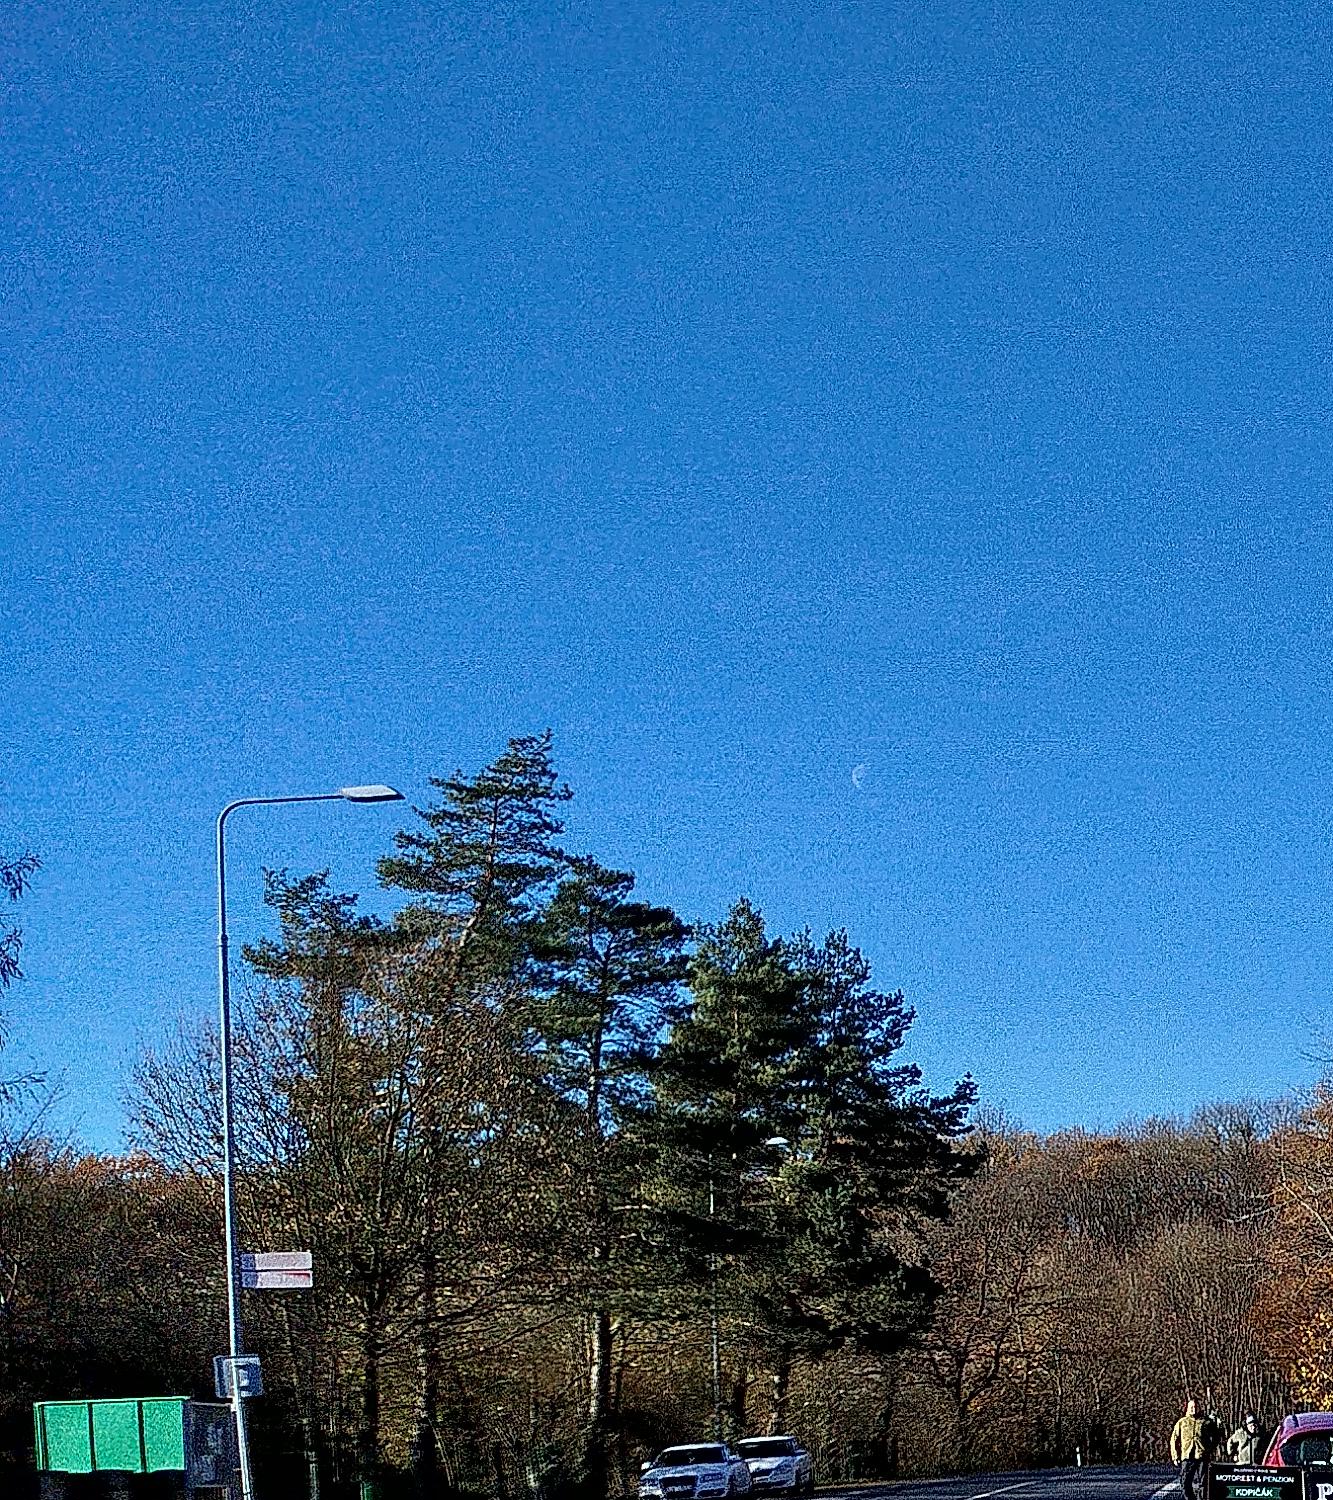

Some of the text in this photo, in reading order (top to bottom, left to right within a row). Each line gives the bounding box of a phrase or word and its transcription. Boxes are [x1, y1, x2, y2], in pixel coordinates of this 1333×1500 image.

[1215, 1474, 1255, 1482] MOTOREST
[1262, 1475, 1295, 1483] PENZION
[1235, 1486, 1273, 1497] KOPIČÁK
